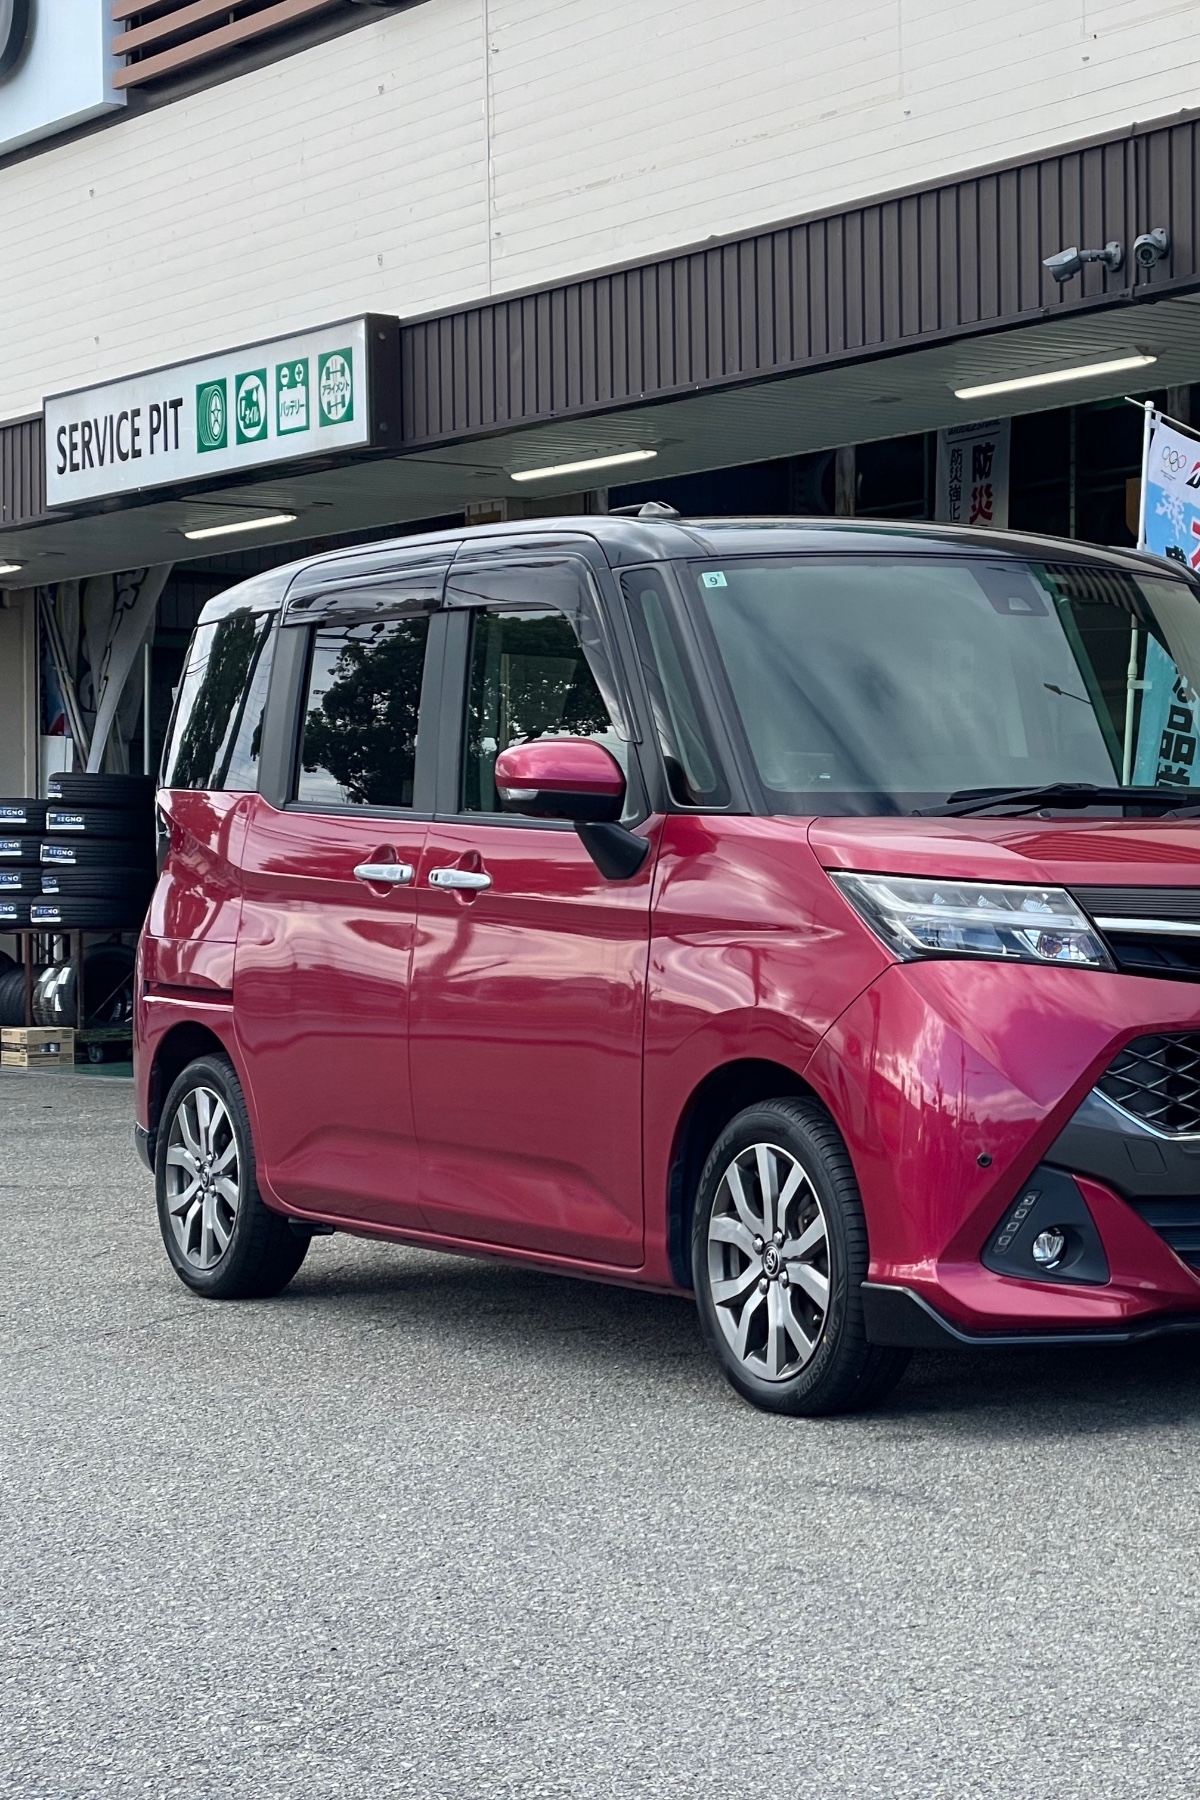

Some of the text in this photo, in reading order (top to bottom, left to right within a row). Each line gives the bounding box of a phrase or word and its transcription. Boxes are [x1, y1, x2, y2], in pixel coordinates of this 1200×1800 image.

[280, 398, 305, 418] バッテリー
[321, 379, 350, 397] アライメント
[56, 397, 183, 475] SERVICE PIT
[948, 448, 962, 522] 防災強化
[969, 442, 995, 525] 防災
[709, 576, 718, 586] 9
